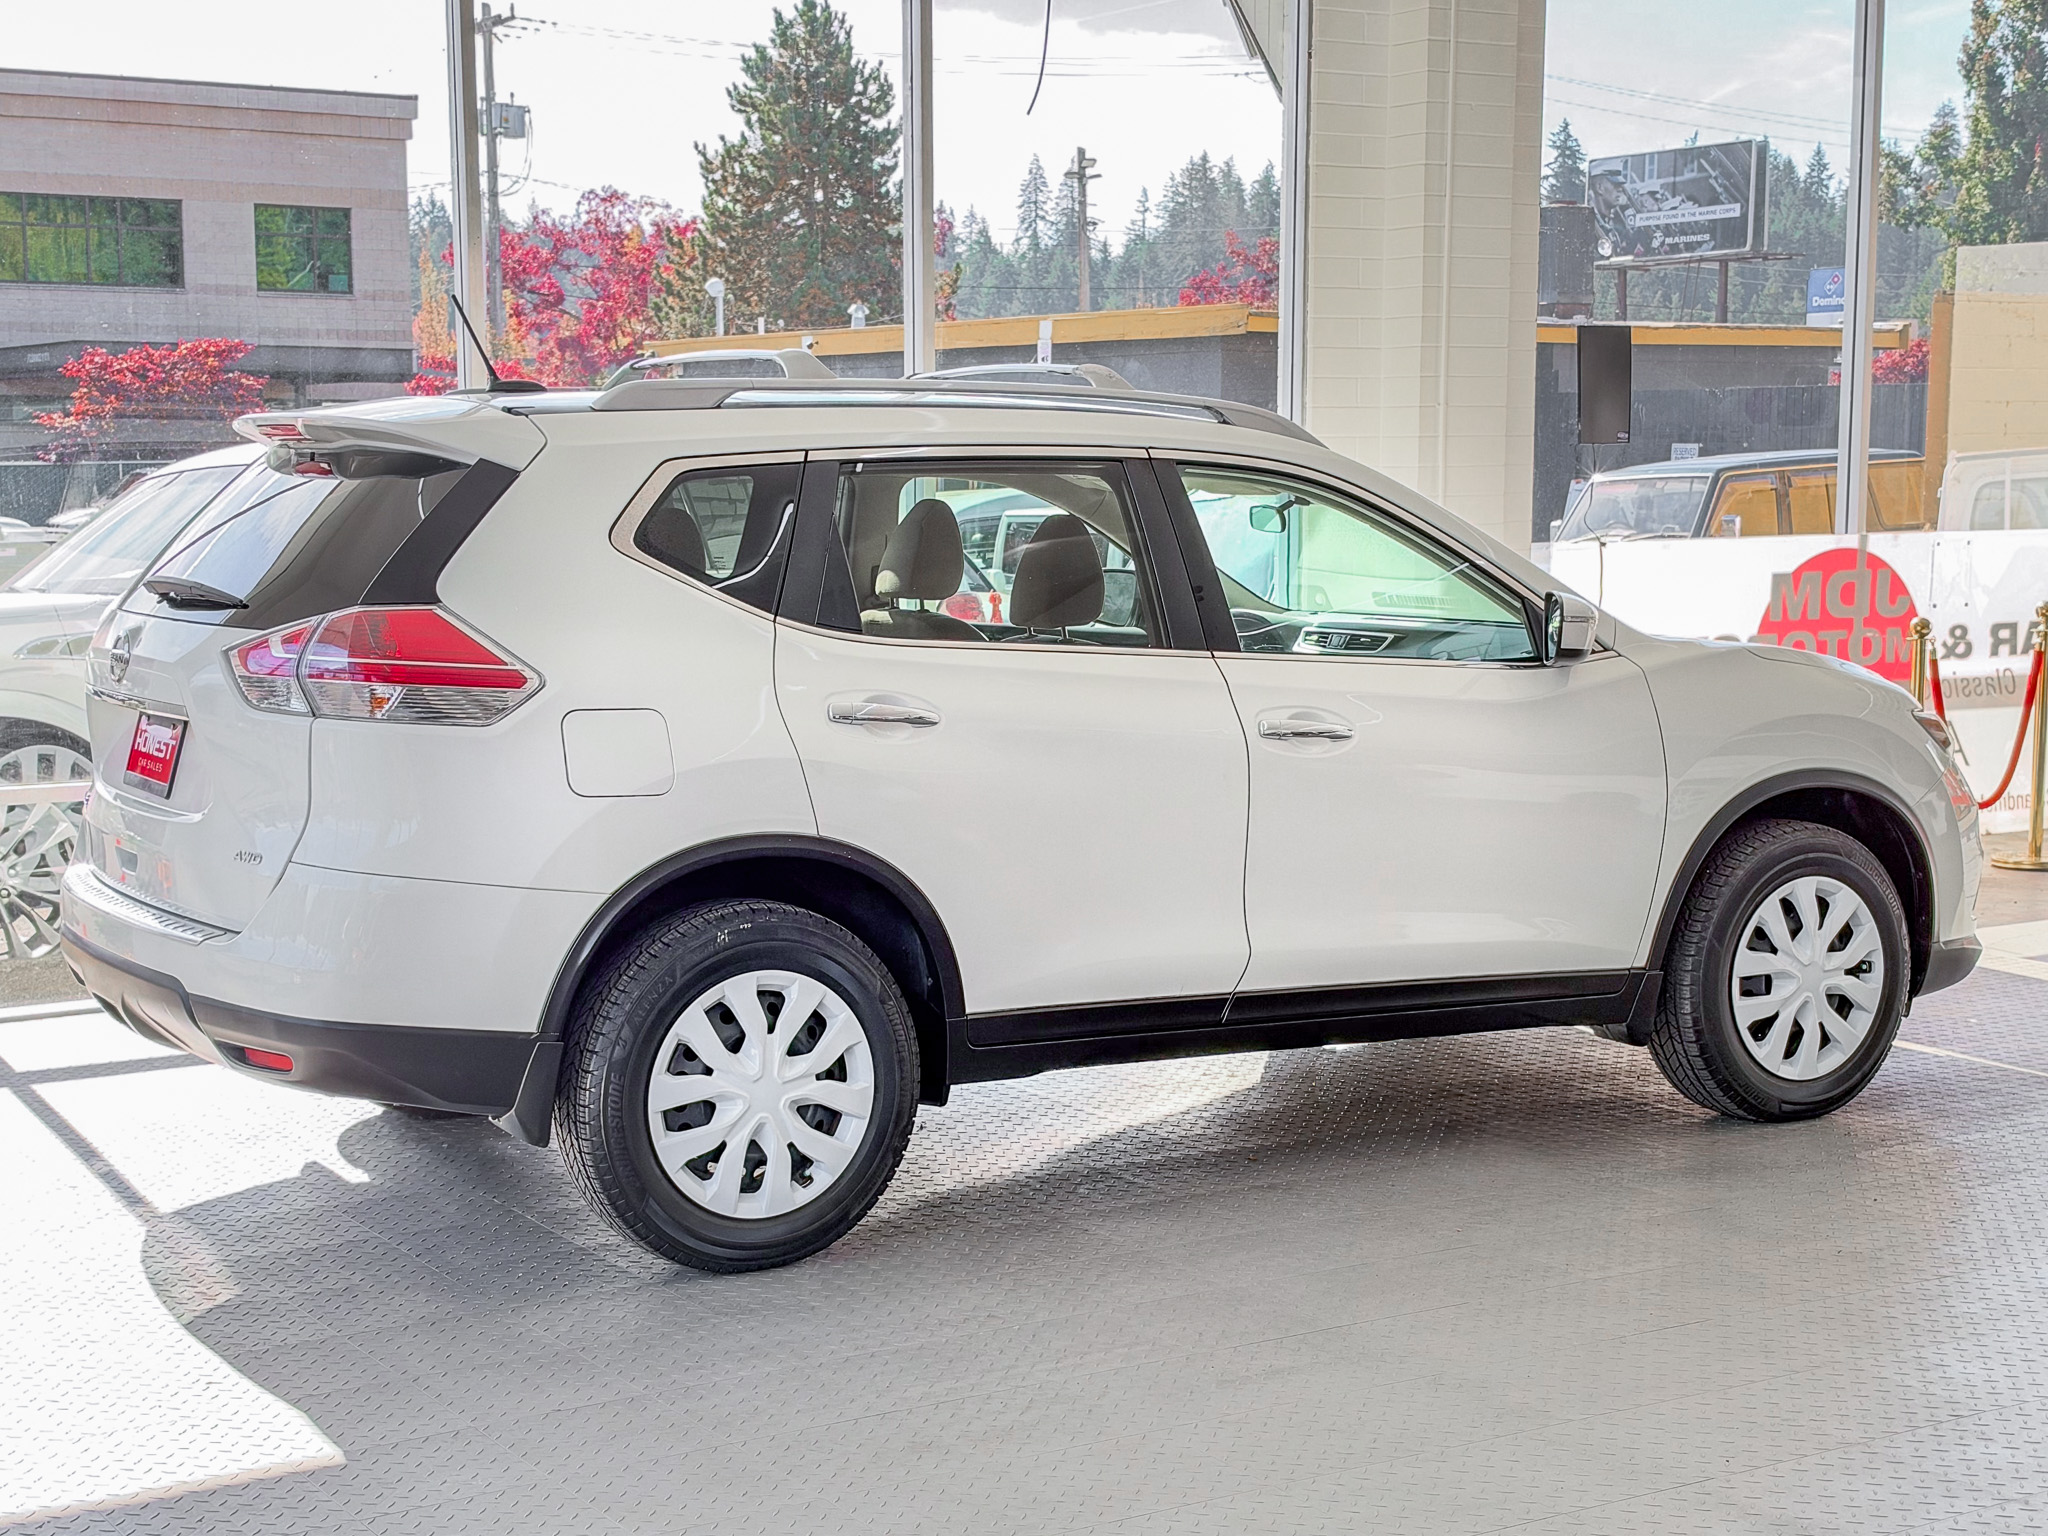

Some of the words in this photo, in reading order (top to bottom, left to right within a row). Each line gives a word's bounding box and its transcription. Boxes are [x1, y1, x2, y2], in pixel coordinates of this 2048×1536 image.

[1639, 214, 1662, 224] PURPOSE
[1662, 213, 1680, 222] FOUND
[1681, 212, 1686, 220] IN
[1687, 211, 1697, 219] THE
[1698, 209, 1718, 218] MARINE
[1718, 207, 1736, 216] CORPS
[1664, 233, 1710, 245] MARINES
[134, 729, 177, 760] HONEST
[146, 759, 163, 773] SALES
[232, 850, 264, 866] AWD
